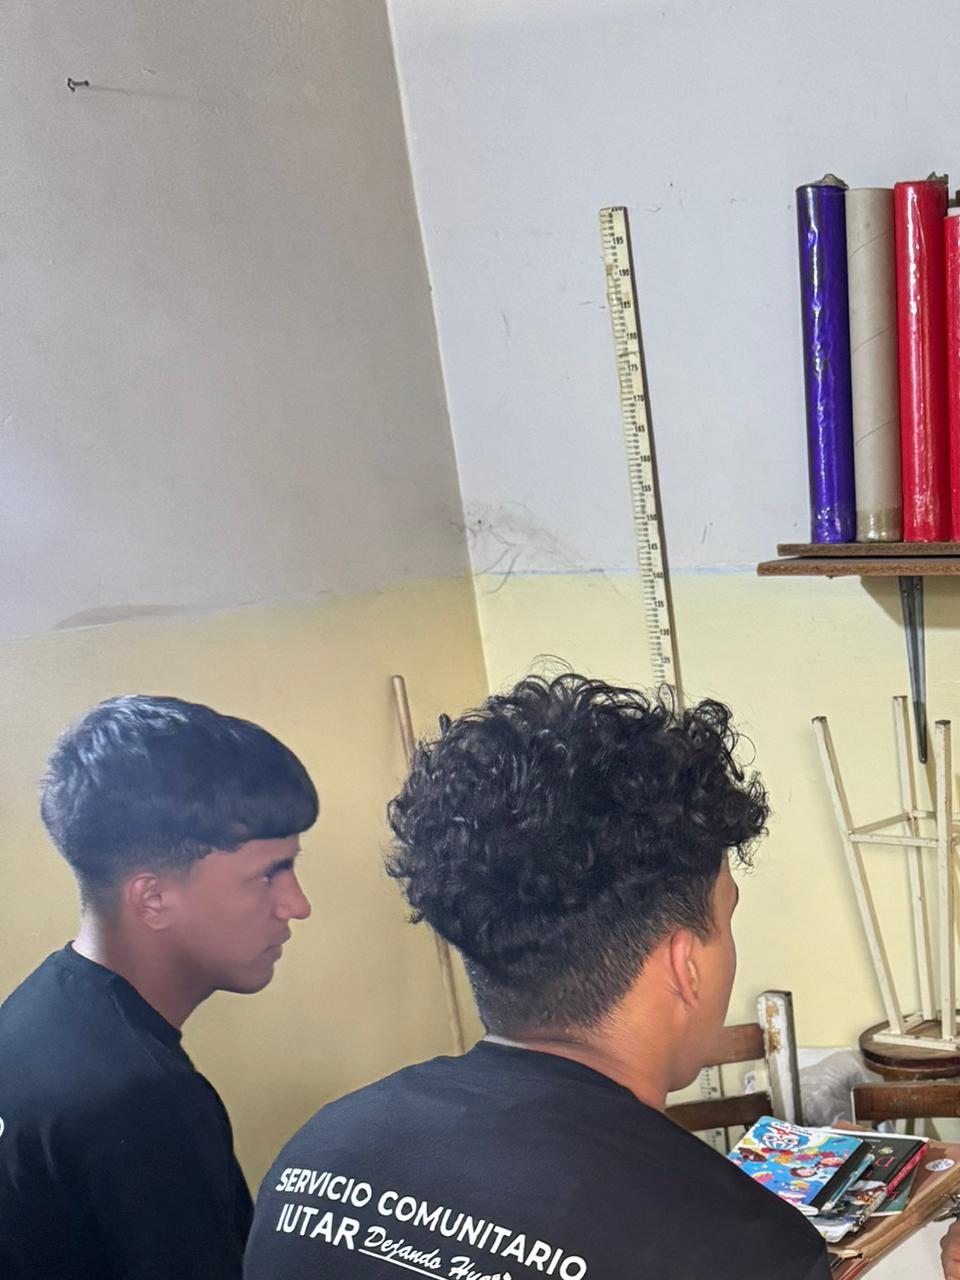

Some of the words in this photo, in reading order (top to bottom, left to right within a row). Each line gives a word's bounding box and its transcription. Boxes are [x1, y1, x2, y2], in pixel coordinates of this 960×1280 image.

[275, 1167, 373, 1208] SERVICIO
[276, 1203, 361, 1251] IUTAR
[363, 1225, 442, 1270] Dejando
